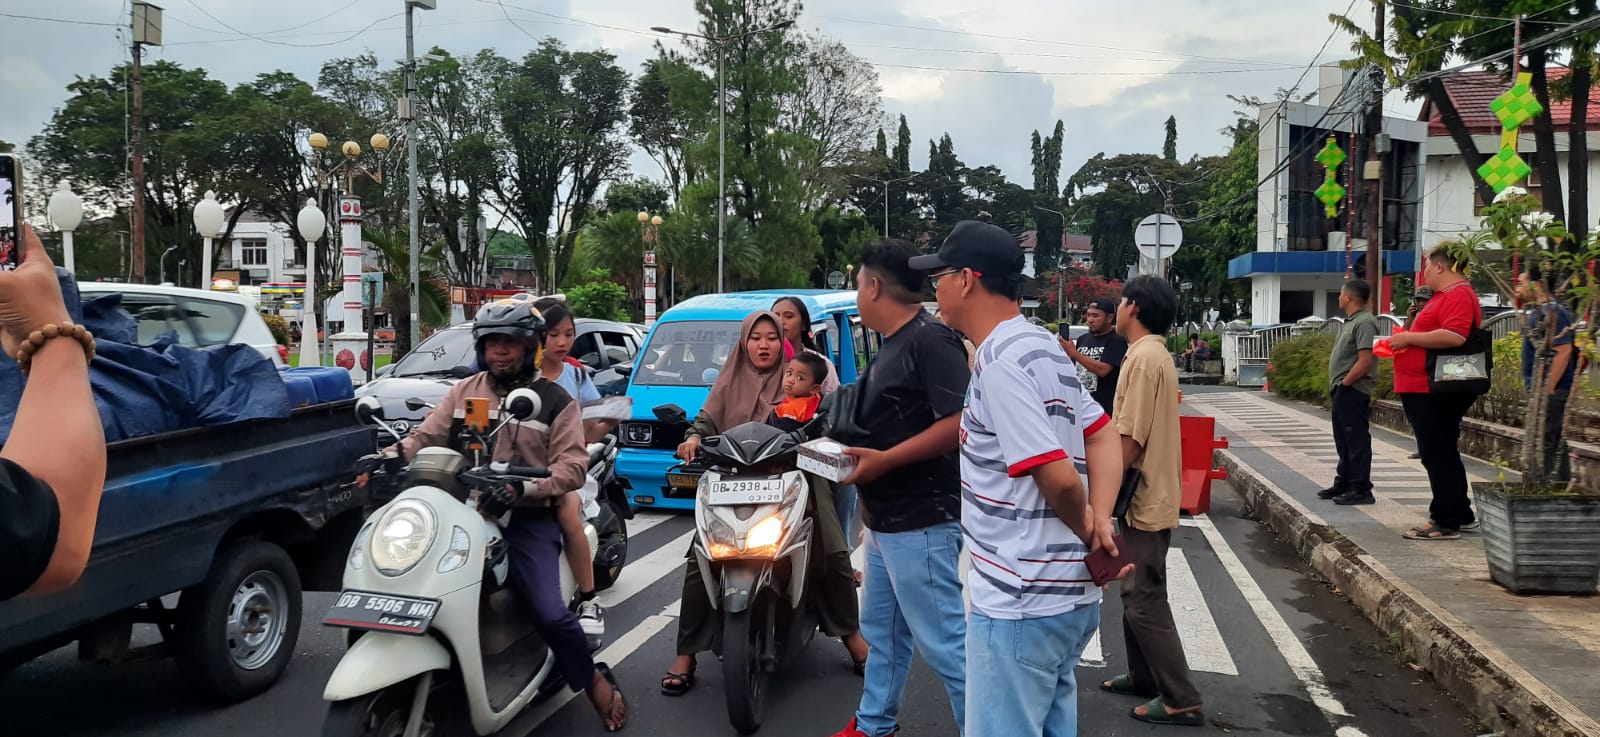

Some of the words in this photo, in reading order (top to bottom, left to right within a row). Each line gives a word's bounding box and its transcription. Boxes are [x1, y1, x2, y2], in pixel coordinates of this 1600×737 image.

[712, 483, 728, 493] DB
[732, 482, 761, 492] 2938
[767, 481, 781, 491] LJ
[339, 594, 362, 609] DB
[364, 597, 405, 613] 5506
